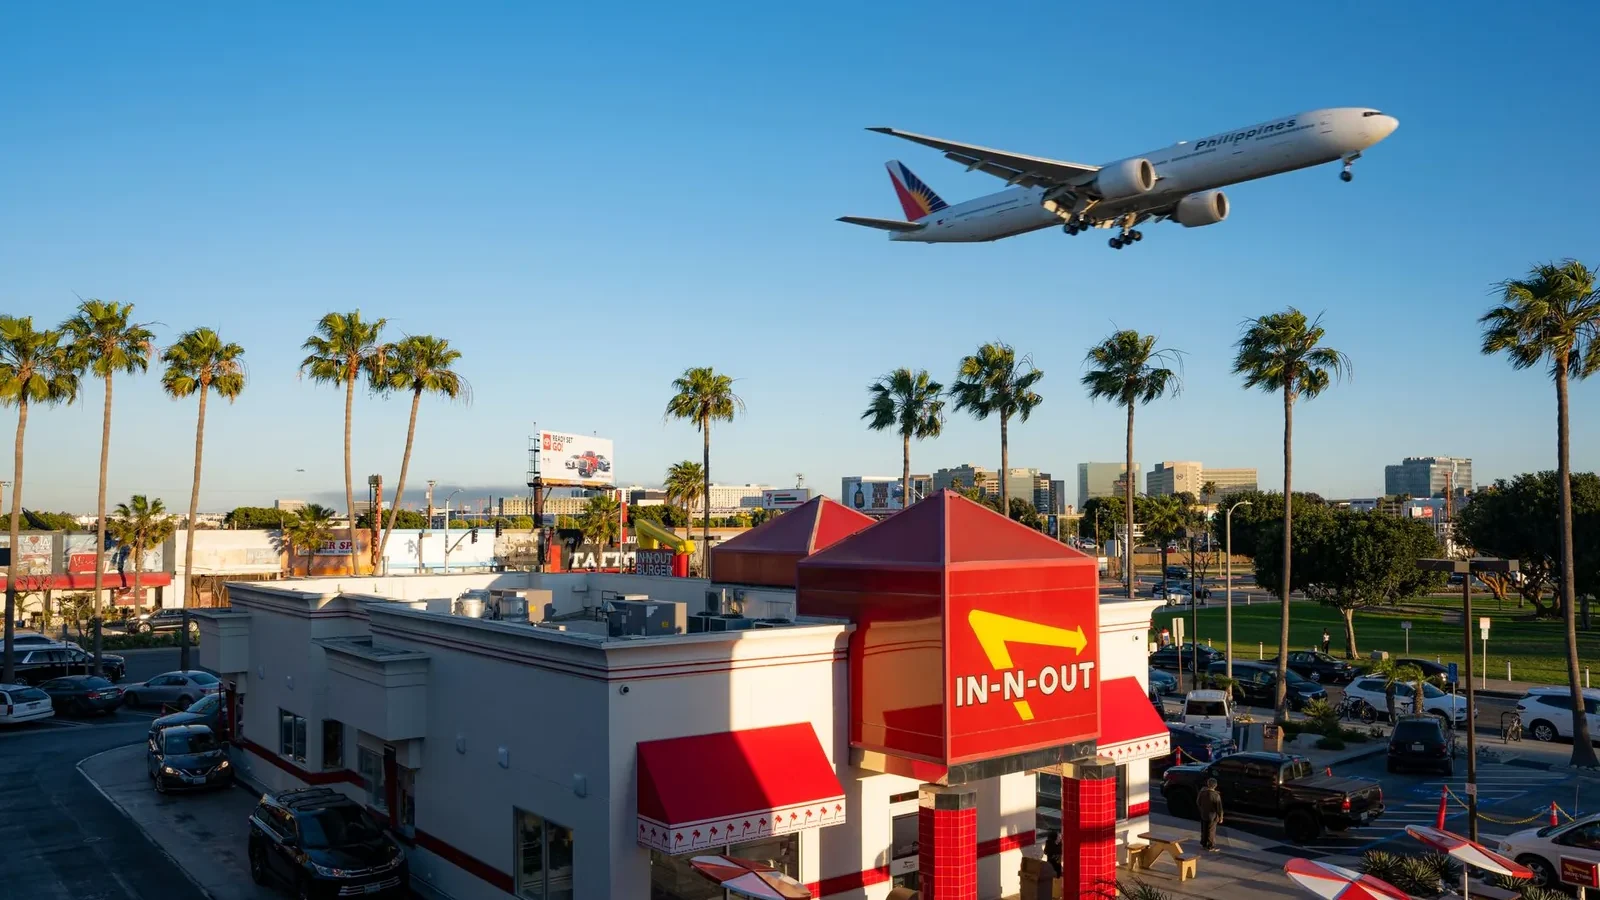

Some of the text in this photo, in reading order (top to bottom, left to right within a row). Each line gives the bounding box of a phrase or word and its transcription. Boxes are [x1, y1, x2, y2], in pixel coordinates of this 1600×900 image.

[1194, 119, 1297, 151] Philippines
[552, 434, 574, 444] READY SET
[636, 552, 673, 564] IN-N-OUT
[636, 564, 673, 576] BURGER
[956, 662, 1095, 707] IN-N-OUT
